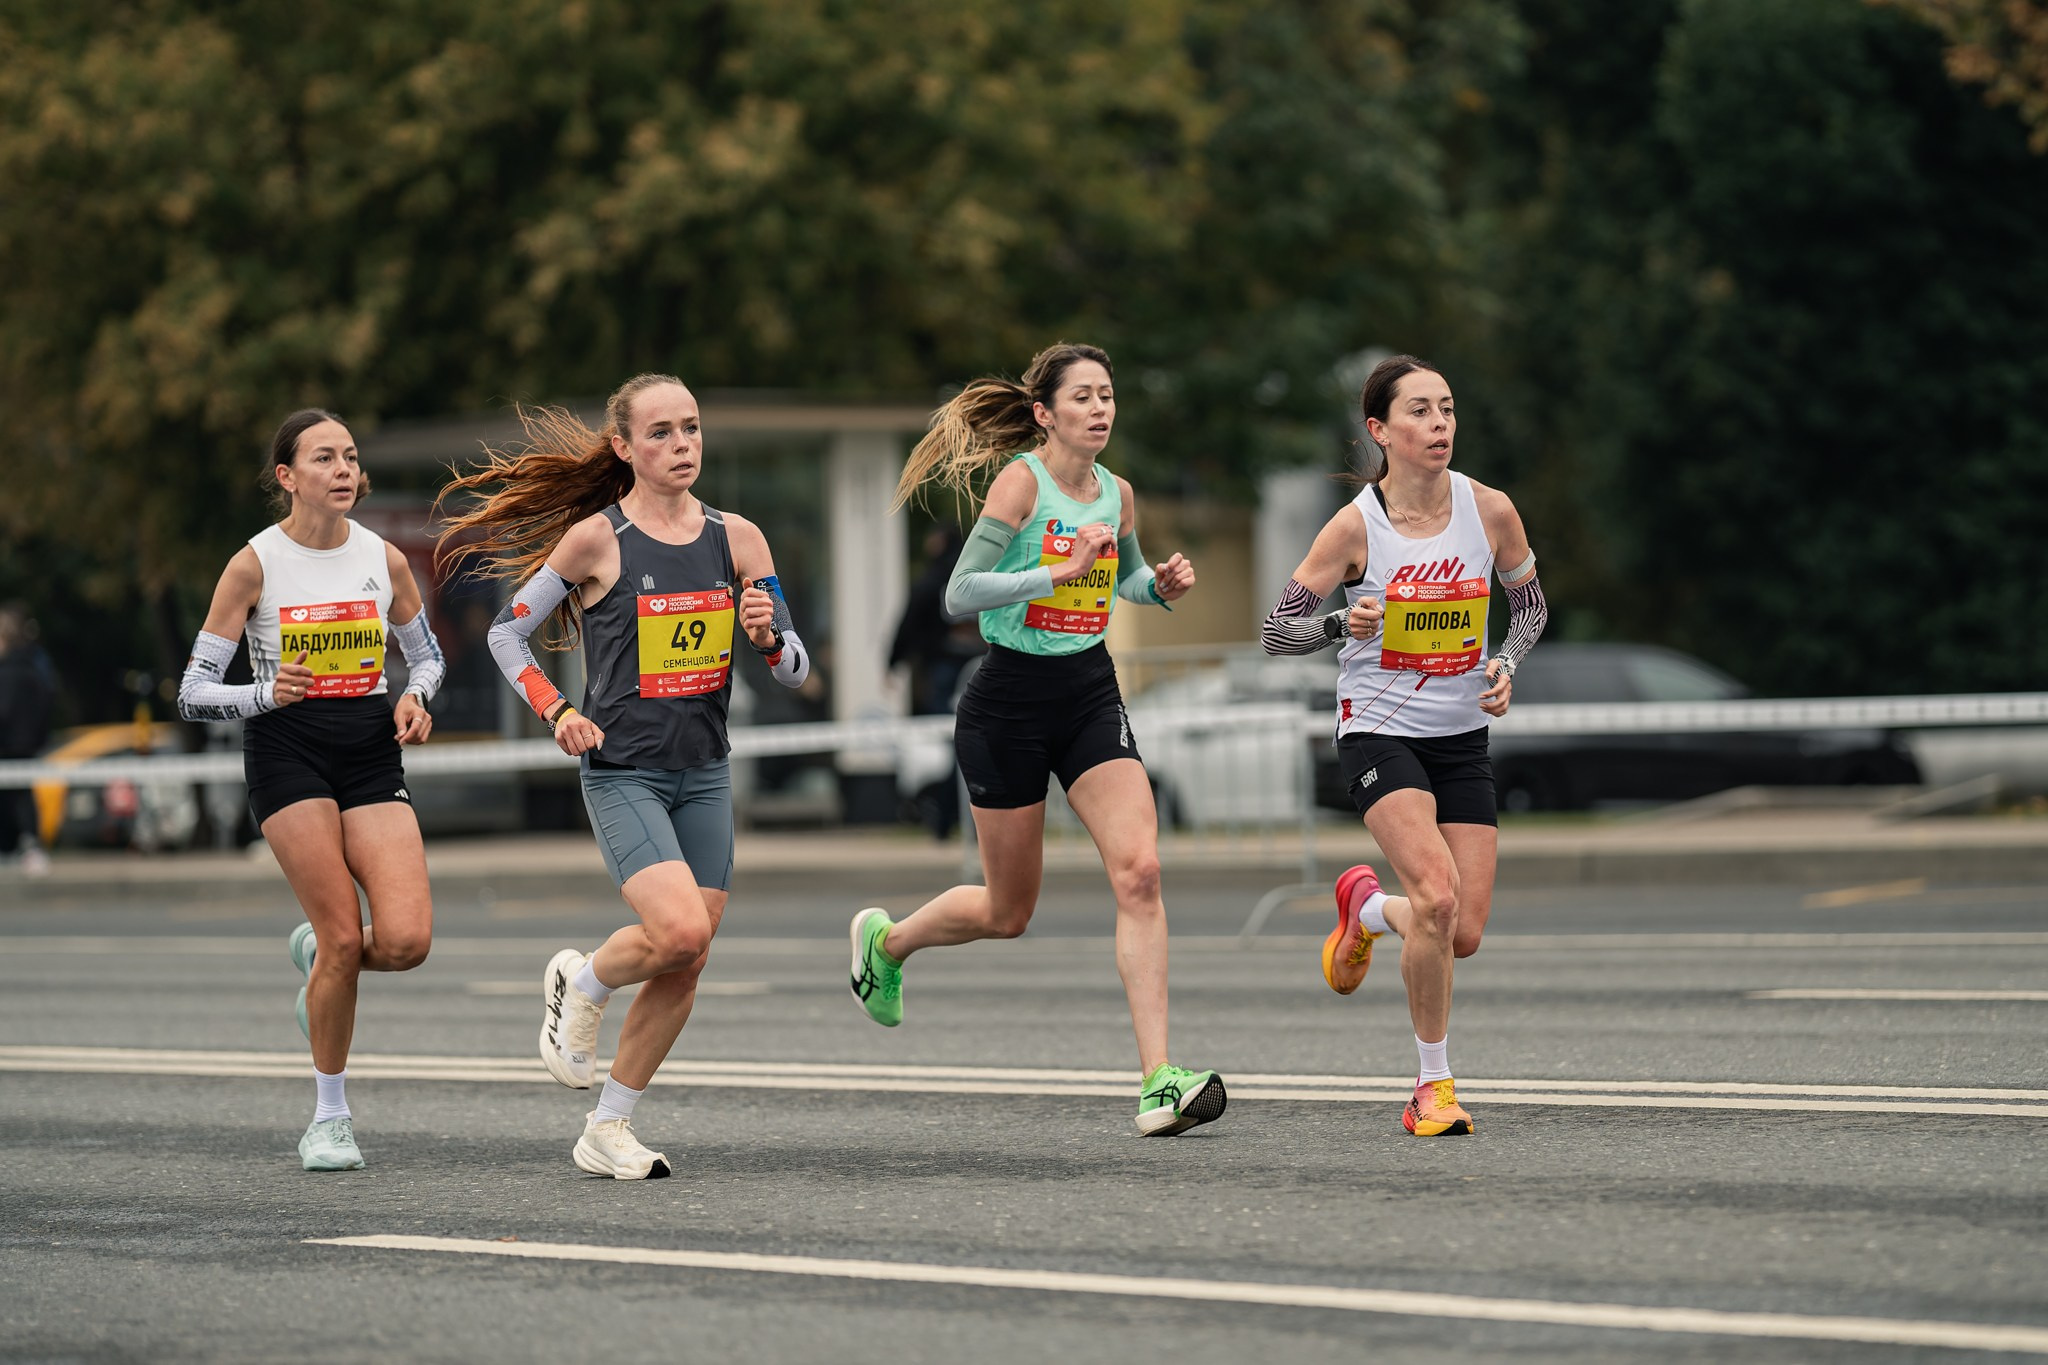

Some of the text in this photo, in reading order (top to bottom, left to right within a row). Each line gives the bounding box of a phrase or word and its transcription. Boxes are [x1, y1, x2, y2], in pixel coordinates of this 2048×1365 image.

[669, 599, 704, 607] МОСКОВСКИЙ
[1073, 599, 1081, 607] 58
[1405, 610, 1471, 631] ПОПОВА
[282, 629, 383, 655] ГАБДУЛЛИНА
[671, 620, 706, 651] 49
[329, 663, 339, 671] 56
[663, 655, 715, 668] СЕМЕНЦОВА
[187, 703, 225, 720] RUNNING
[224, 704, 243, 719] UFA
